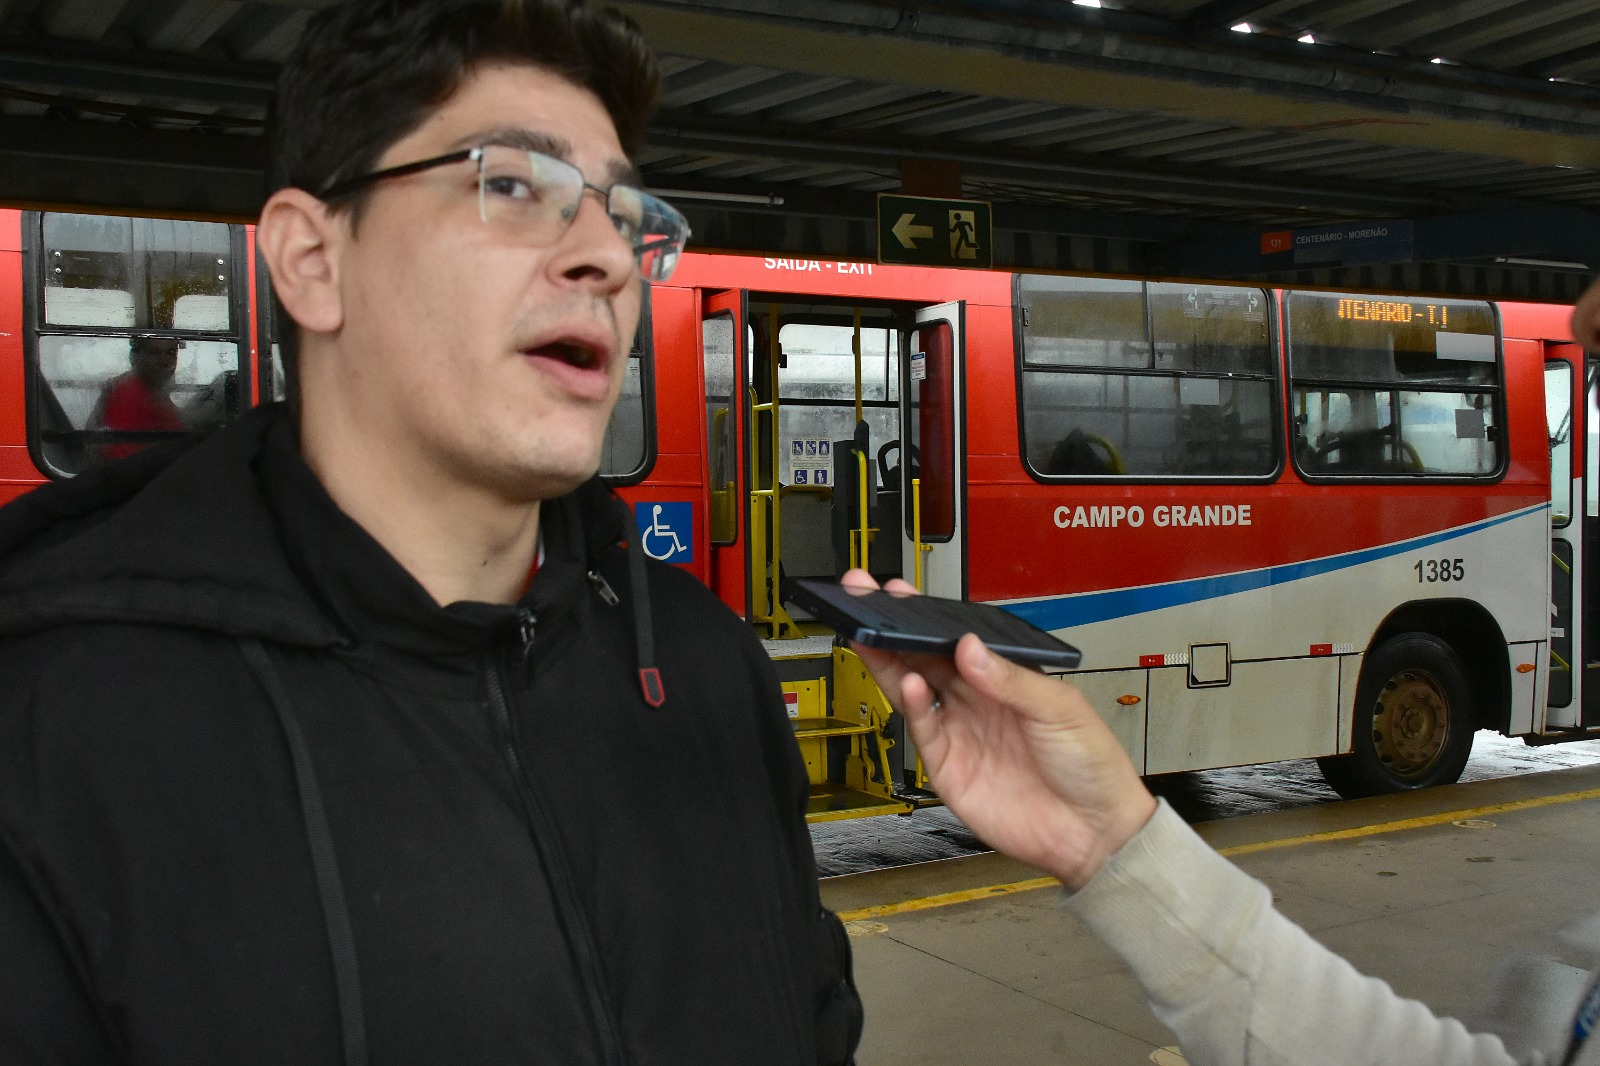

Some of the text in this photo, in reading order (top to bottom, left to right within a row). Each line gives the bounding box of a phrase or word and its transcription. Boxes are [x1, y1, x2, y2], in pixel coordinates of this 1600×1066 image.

[1270, 239, 1282, 247] 131
[1296, 231, 1343, 244] CENTENÁRIO
[1348, 227, 1388, 239] MORENÃO
[1053, 505, 1251, 528] CAMPO GRANDE
[1414, 559, 1464, 583] 1385
